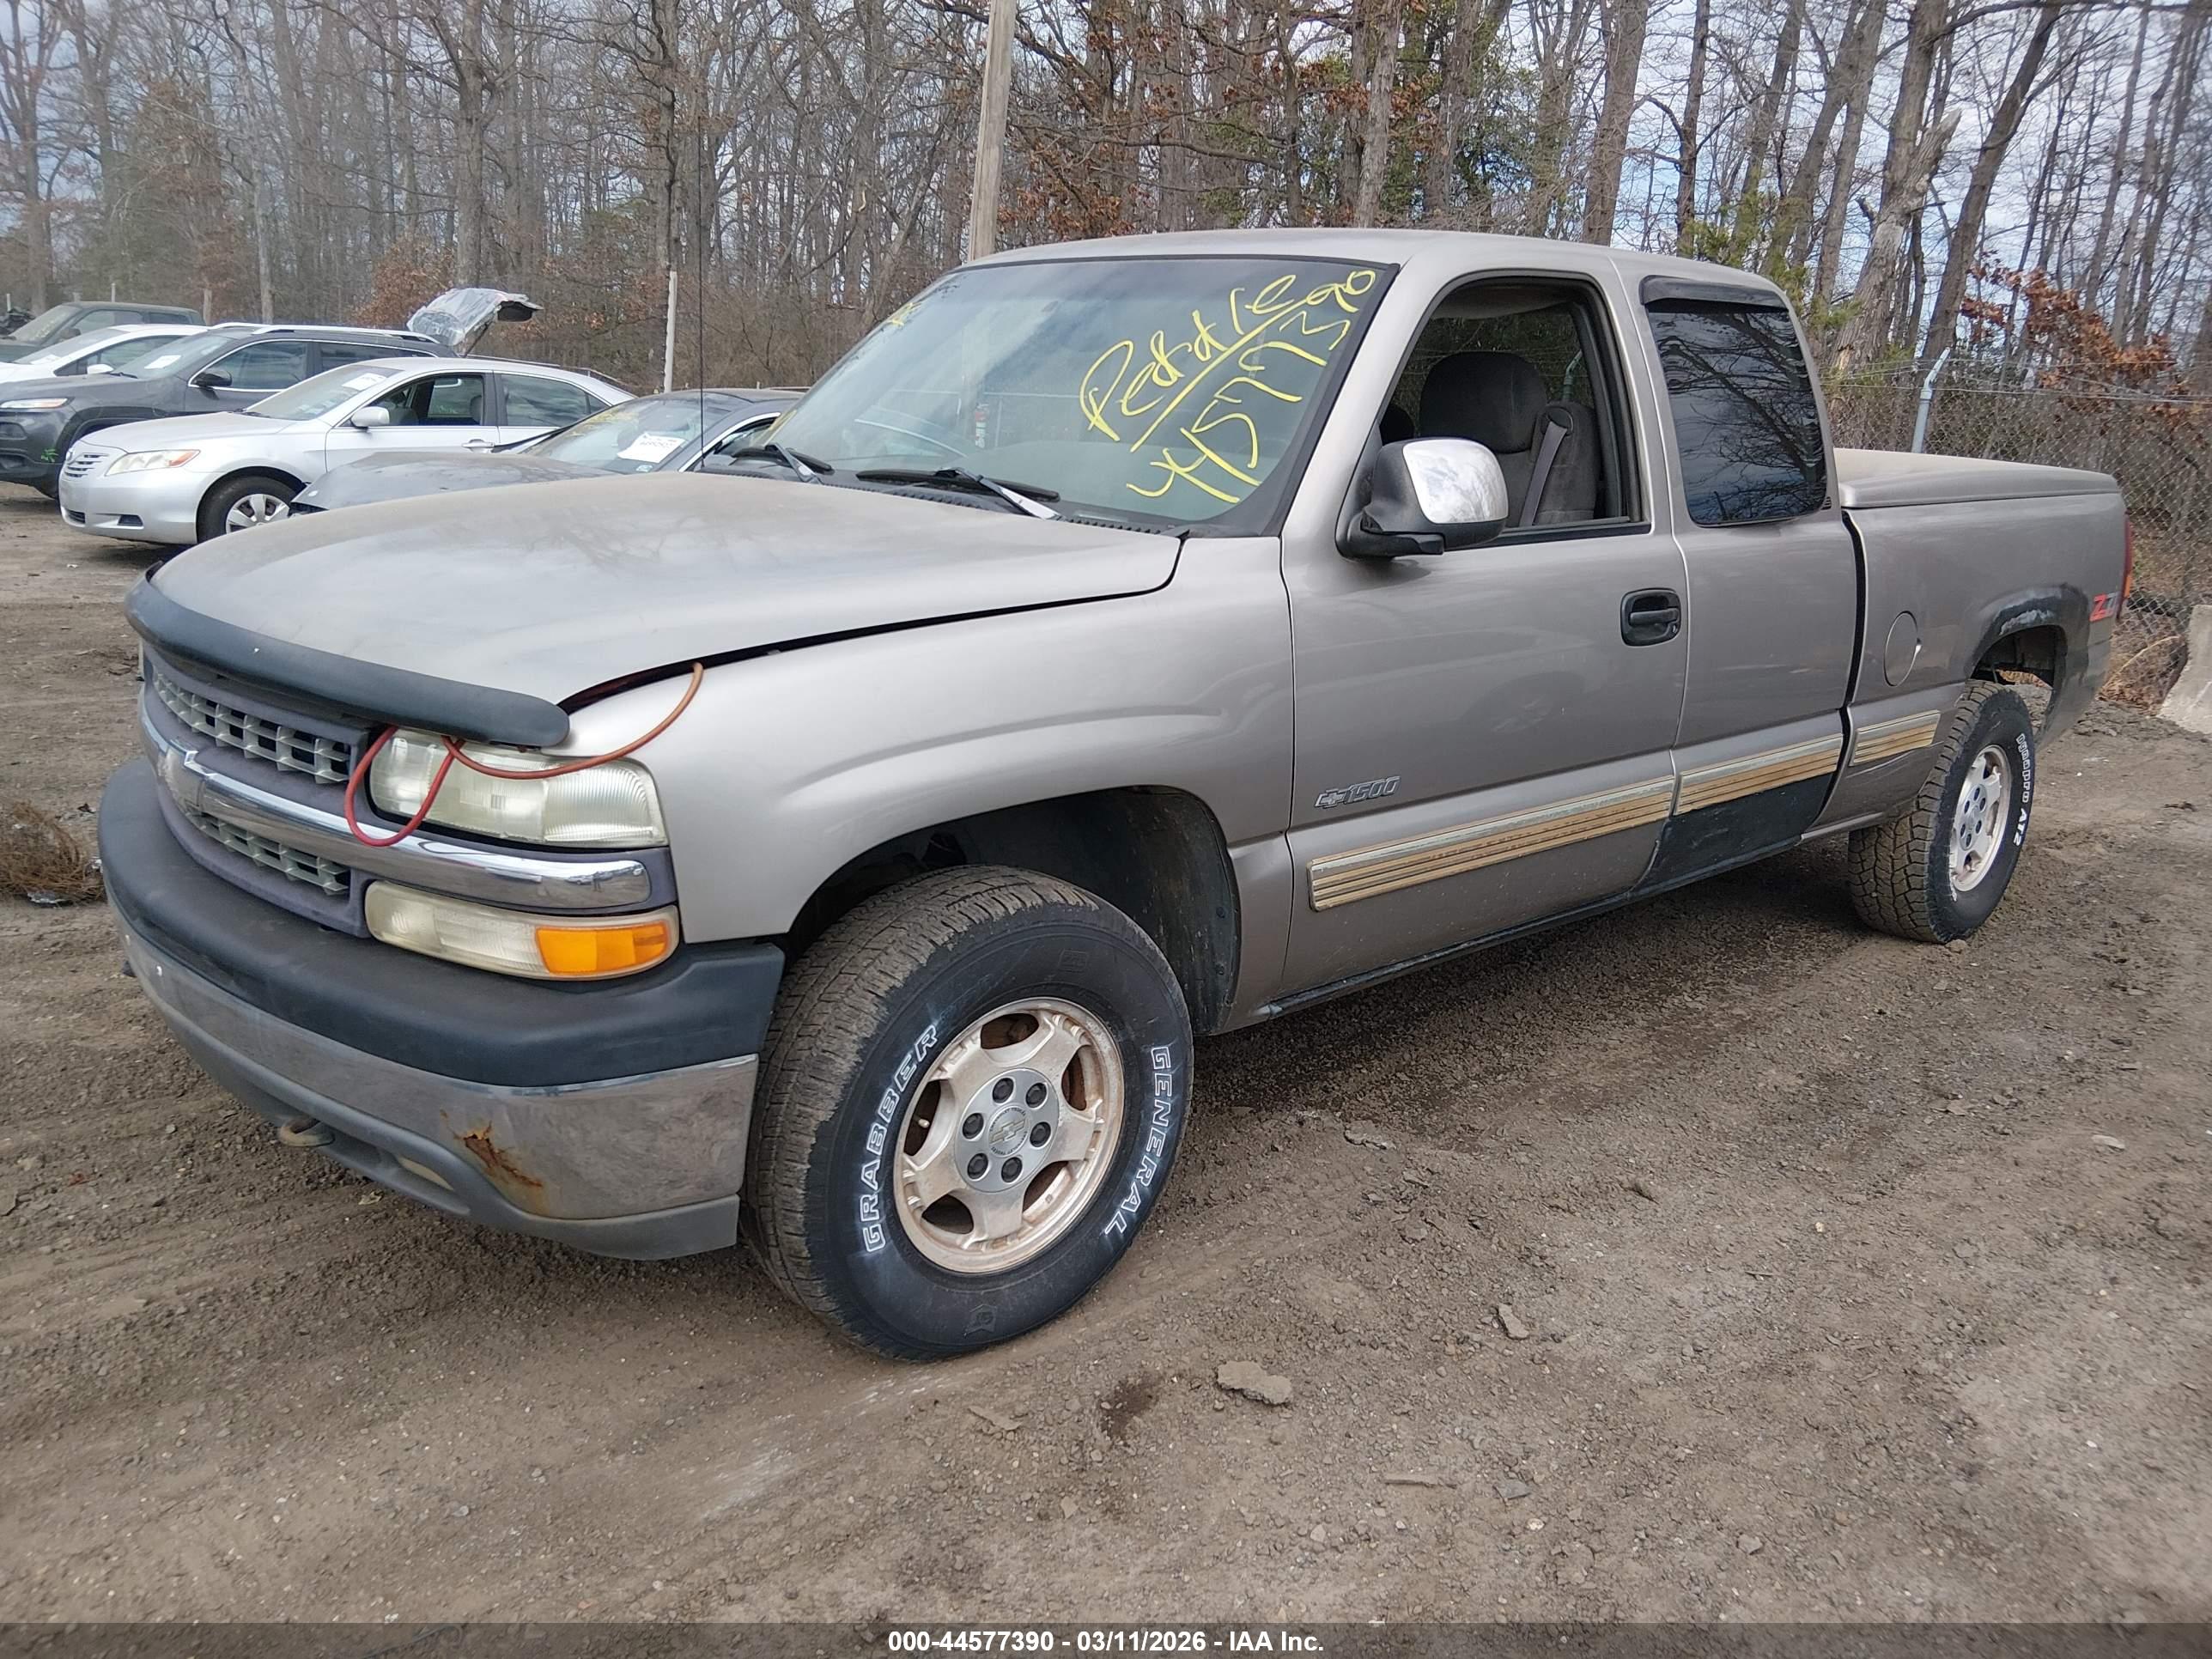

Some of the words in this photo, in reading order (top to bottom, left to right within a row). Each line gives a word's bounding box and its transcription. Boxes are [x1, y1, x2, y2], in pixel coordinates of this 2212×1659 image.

[1126, 270, 1376, 504] 44577390
[1344, 775, 1401, 804] 1500
[2013, 808, 2027, 847] AT2
[860, 1024, 939, 1254] GRABBER
[1104, 1045, 1174, 1237] GENERAL
